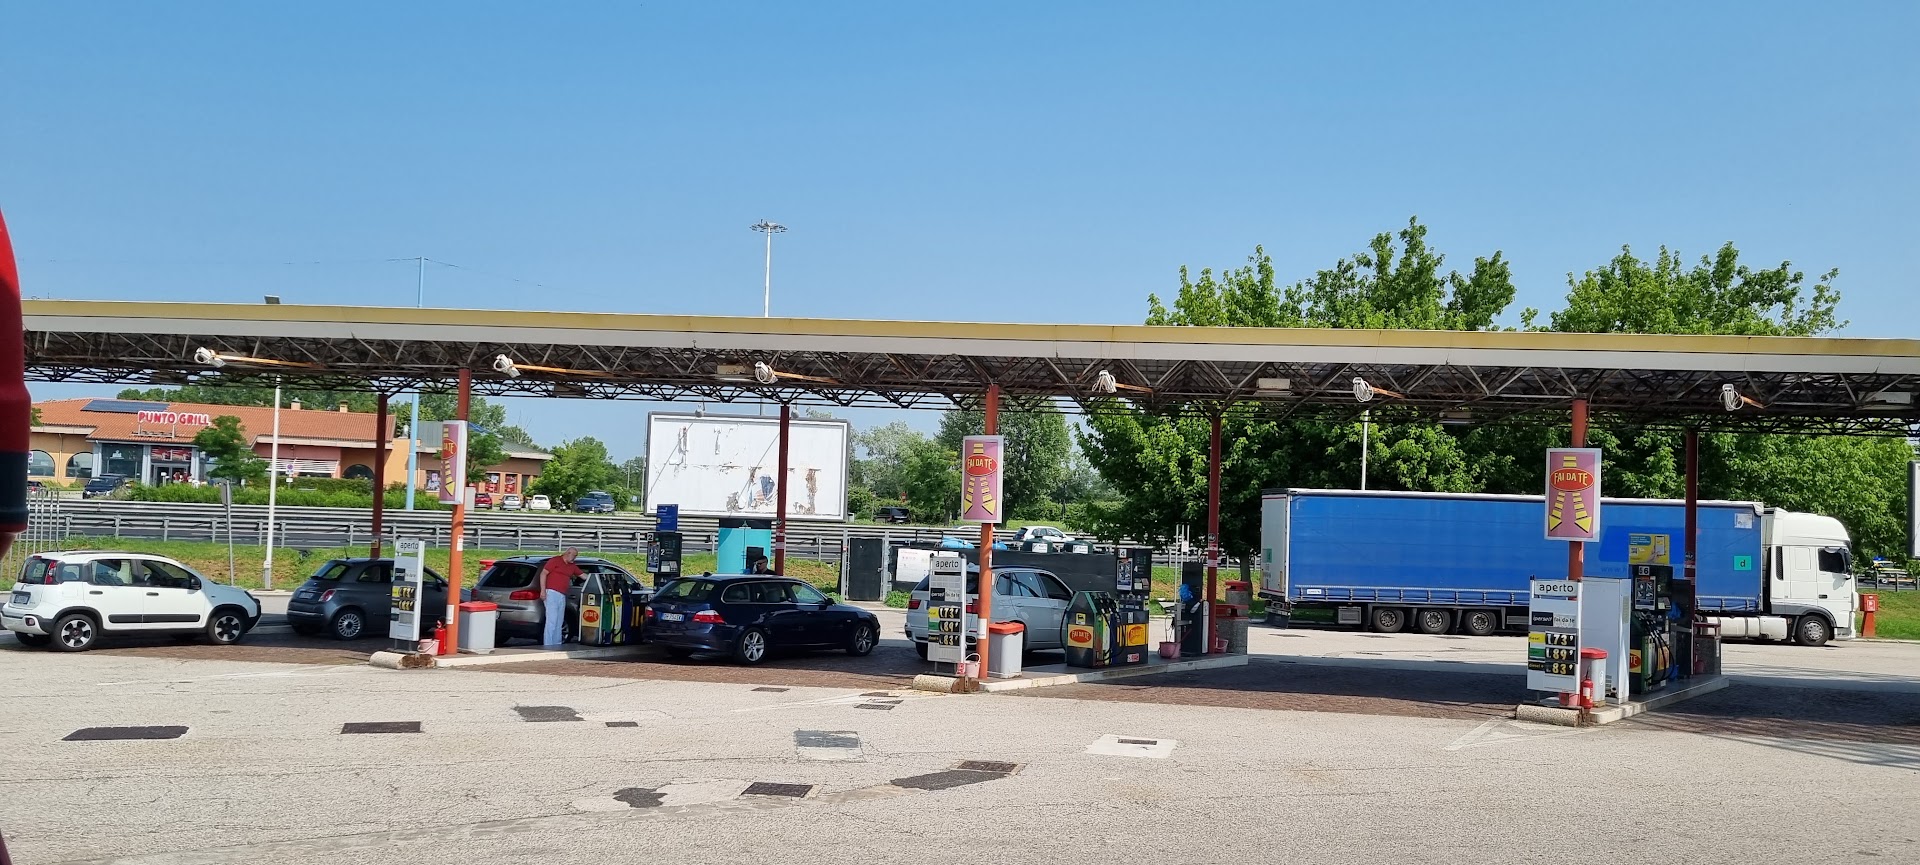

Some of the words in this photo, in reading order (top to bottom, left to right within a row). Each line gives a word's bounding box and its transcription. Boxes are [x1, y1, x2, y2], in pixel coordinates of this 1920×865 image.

[138, 411, 176, 424] PUNTO
[179, 413, 210, 426] GRILL
[985, 459, 993, 471] TE
[1554, 473, 1565, 485] FAI
[1566, 473, 1577, 482] DA
[1578, 473, 1588, 486] TE
[400, 542, 418, 551] aperto
[935, 560, 959, 569] aperto
[1740, 560, 1745, 568] d
[1540, 584, 1574, 593] aperto
